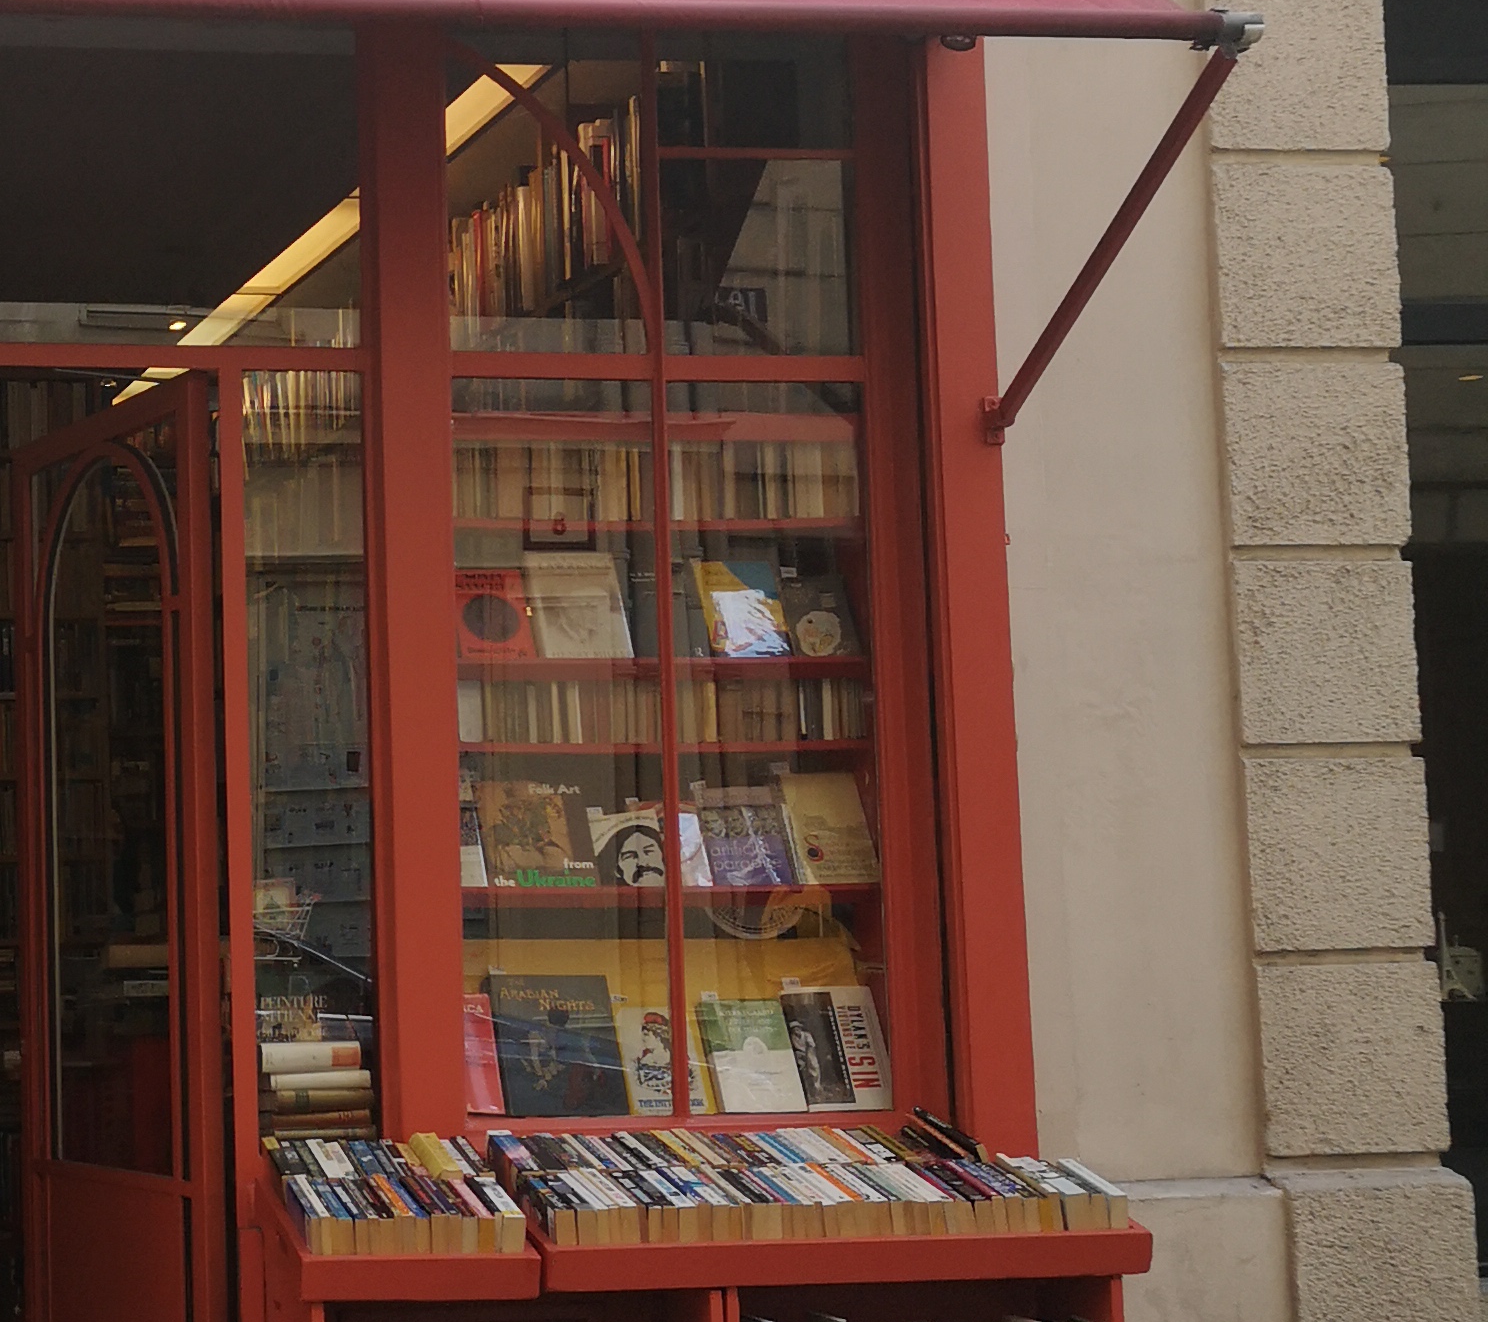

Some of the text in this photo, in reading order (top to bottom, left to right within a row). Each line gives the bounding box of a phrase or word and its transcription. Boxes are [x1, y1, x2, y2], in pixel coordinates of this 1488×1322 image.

[528, 784, 580, 794] Folk Art
[563, 858, 594, 869] from
[494, 869, 595, 887] the Ukraine
[500, 987, 559, 1001] ARABIAN
[262, 995, 328, 1008] PEINTURE
[539, 999, 595, 1011] NIGHTS
[848, 1056, 882, 1089] SIN
